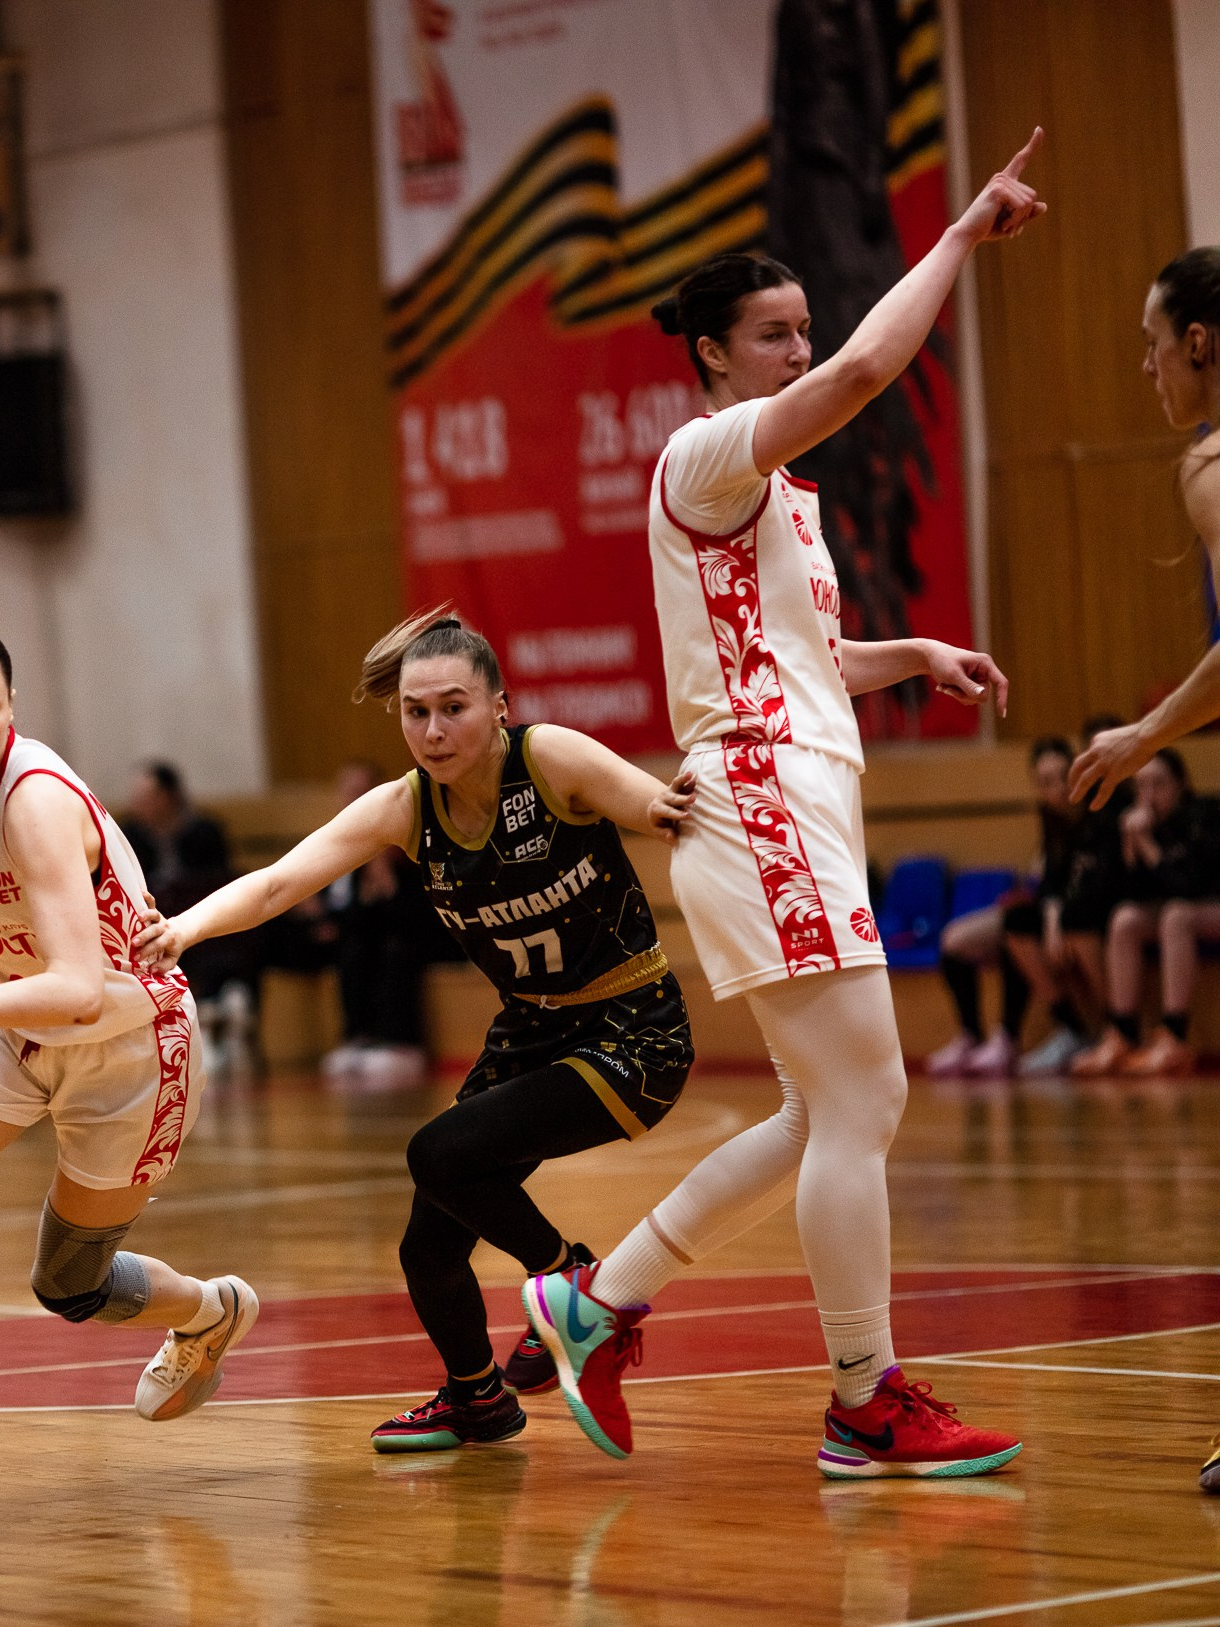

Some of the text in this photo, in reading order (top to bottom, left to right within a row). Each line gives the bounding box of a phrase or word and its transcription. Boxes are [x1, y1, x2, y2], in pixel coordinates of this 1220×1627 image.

[502, 786, 536, 817] FON
[505, 803, 536, 834] BET
[493, 928, 564, 979] 77
[790, 938, 824, 949] SPORT
